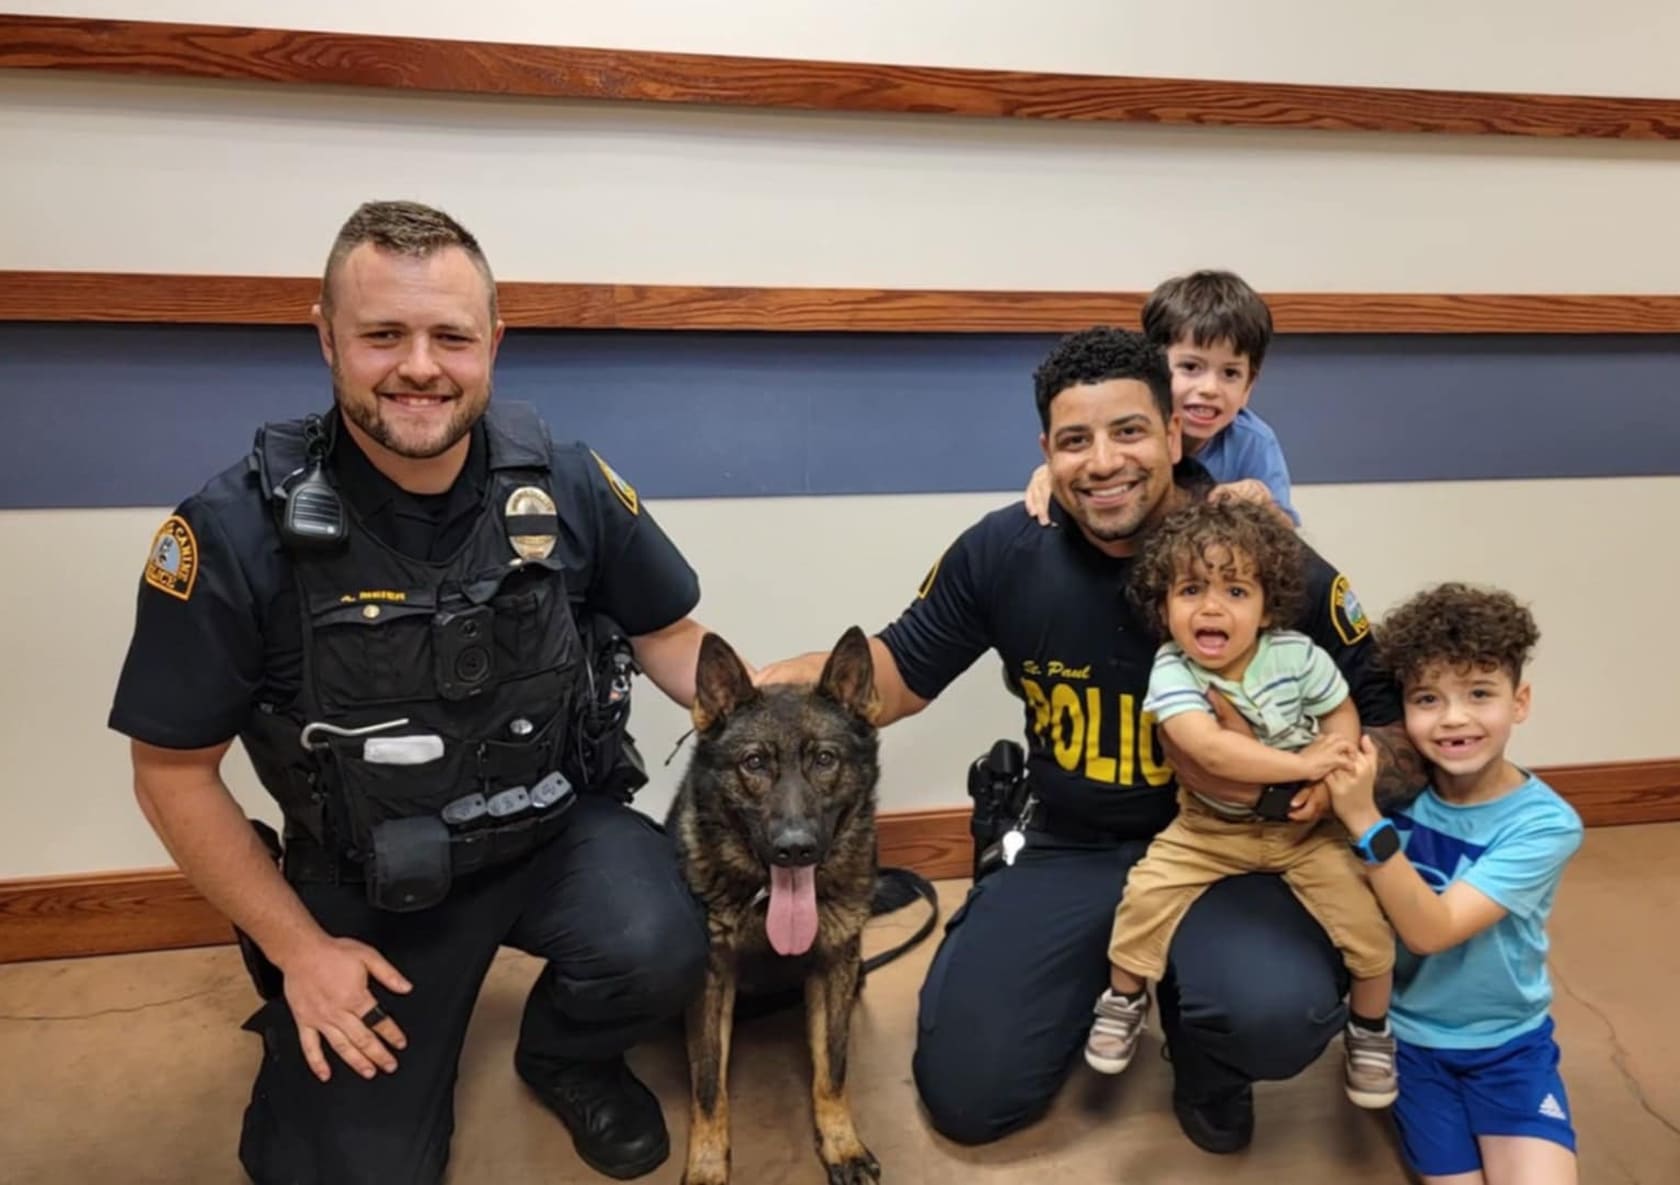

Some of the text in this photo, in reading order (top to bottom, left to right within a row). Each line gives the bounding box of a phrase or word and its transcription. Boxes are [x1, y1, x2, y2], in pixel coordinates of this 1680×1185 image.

[174, 526, 193, 583] CANINE
[1047, 660, 1091, 679] Paul
[1020, 677, 1174, 787] POLIC
